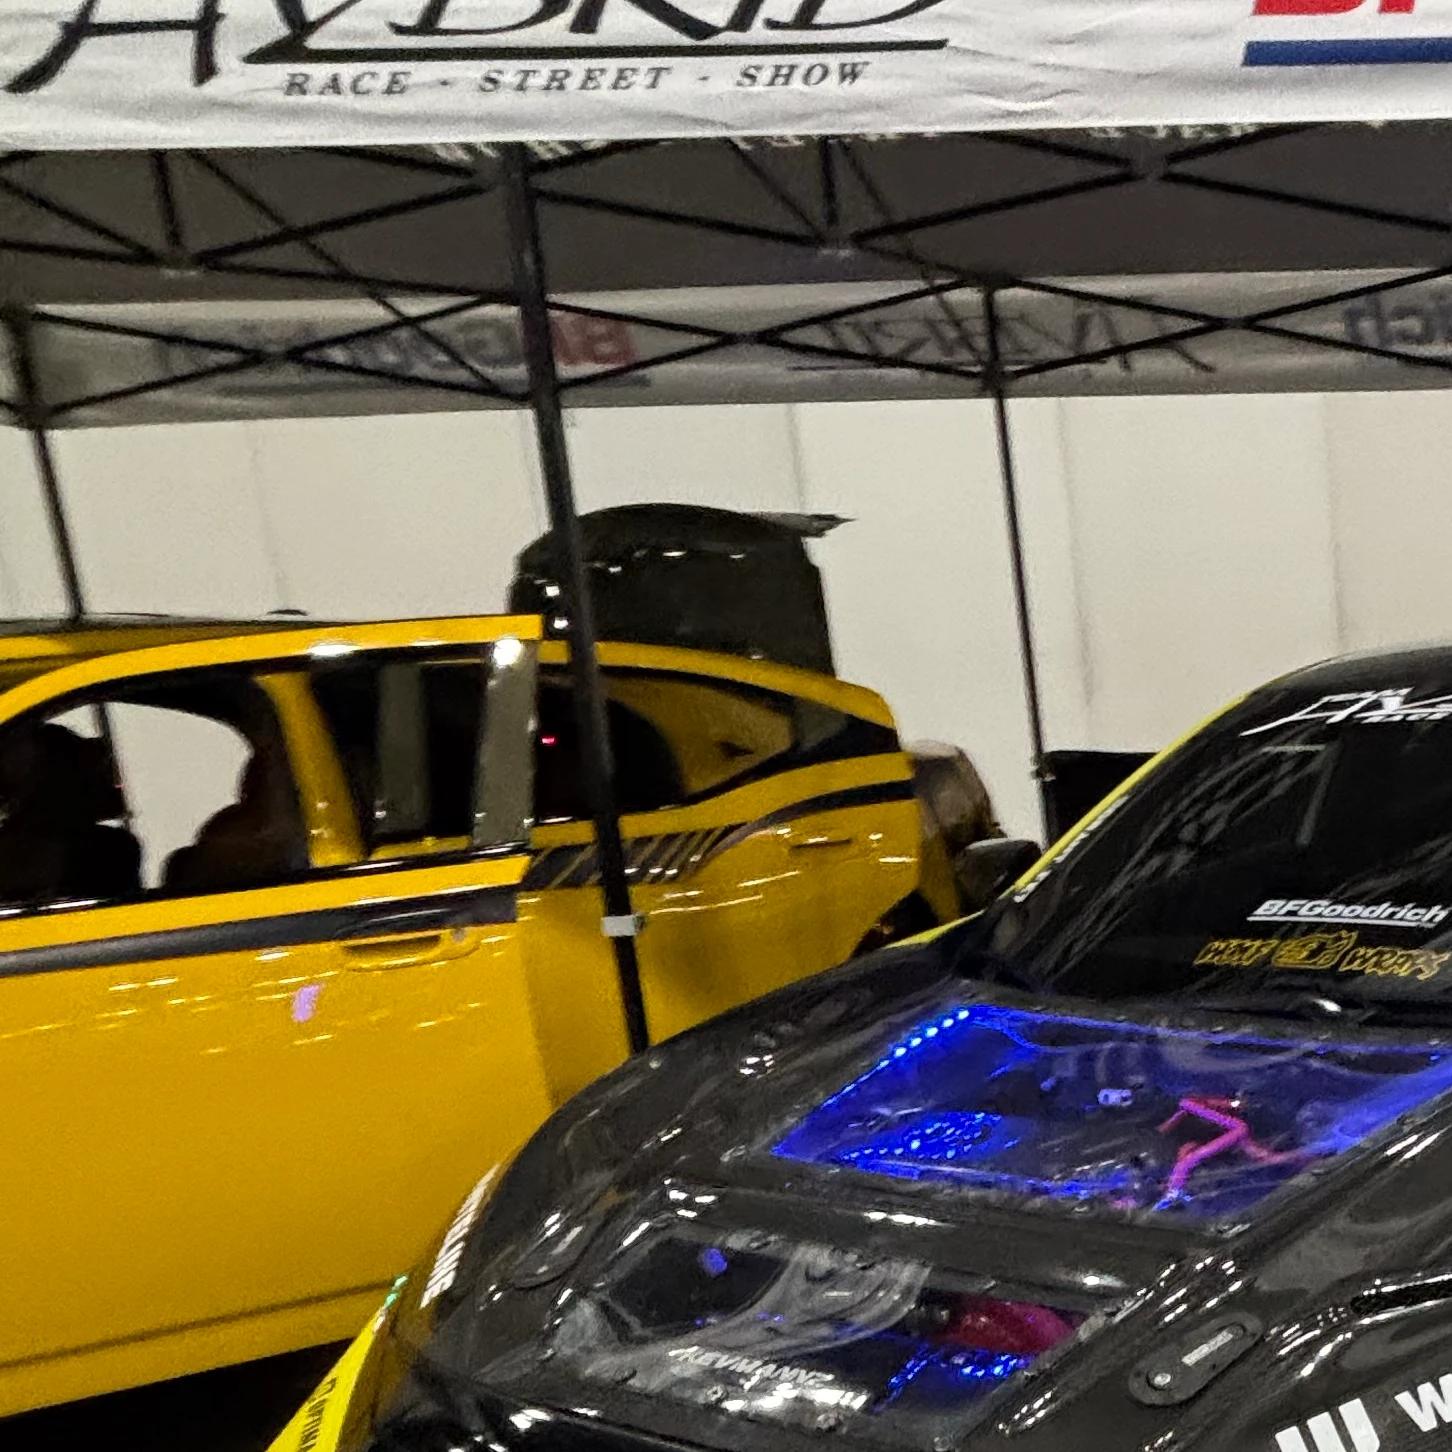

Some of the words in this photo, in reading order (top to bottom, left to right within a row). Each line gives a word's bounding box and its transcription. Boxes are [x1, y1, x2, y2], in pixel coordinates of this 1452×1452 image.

[282, 71, 411, 96] RACE
[478, 66, 673, 94] STREET
[735, 60, 872, 88] SHOW
